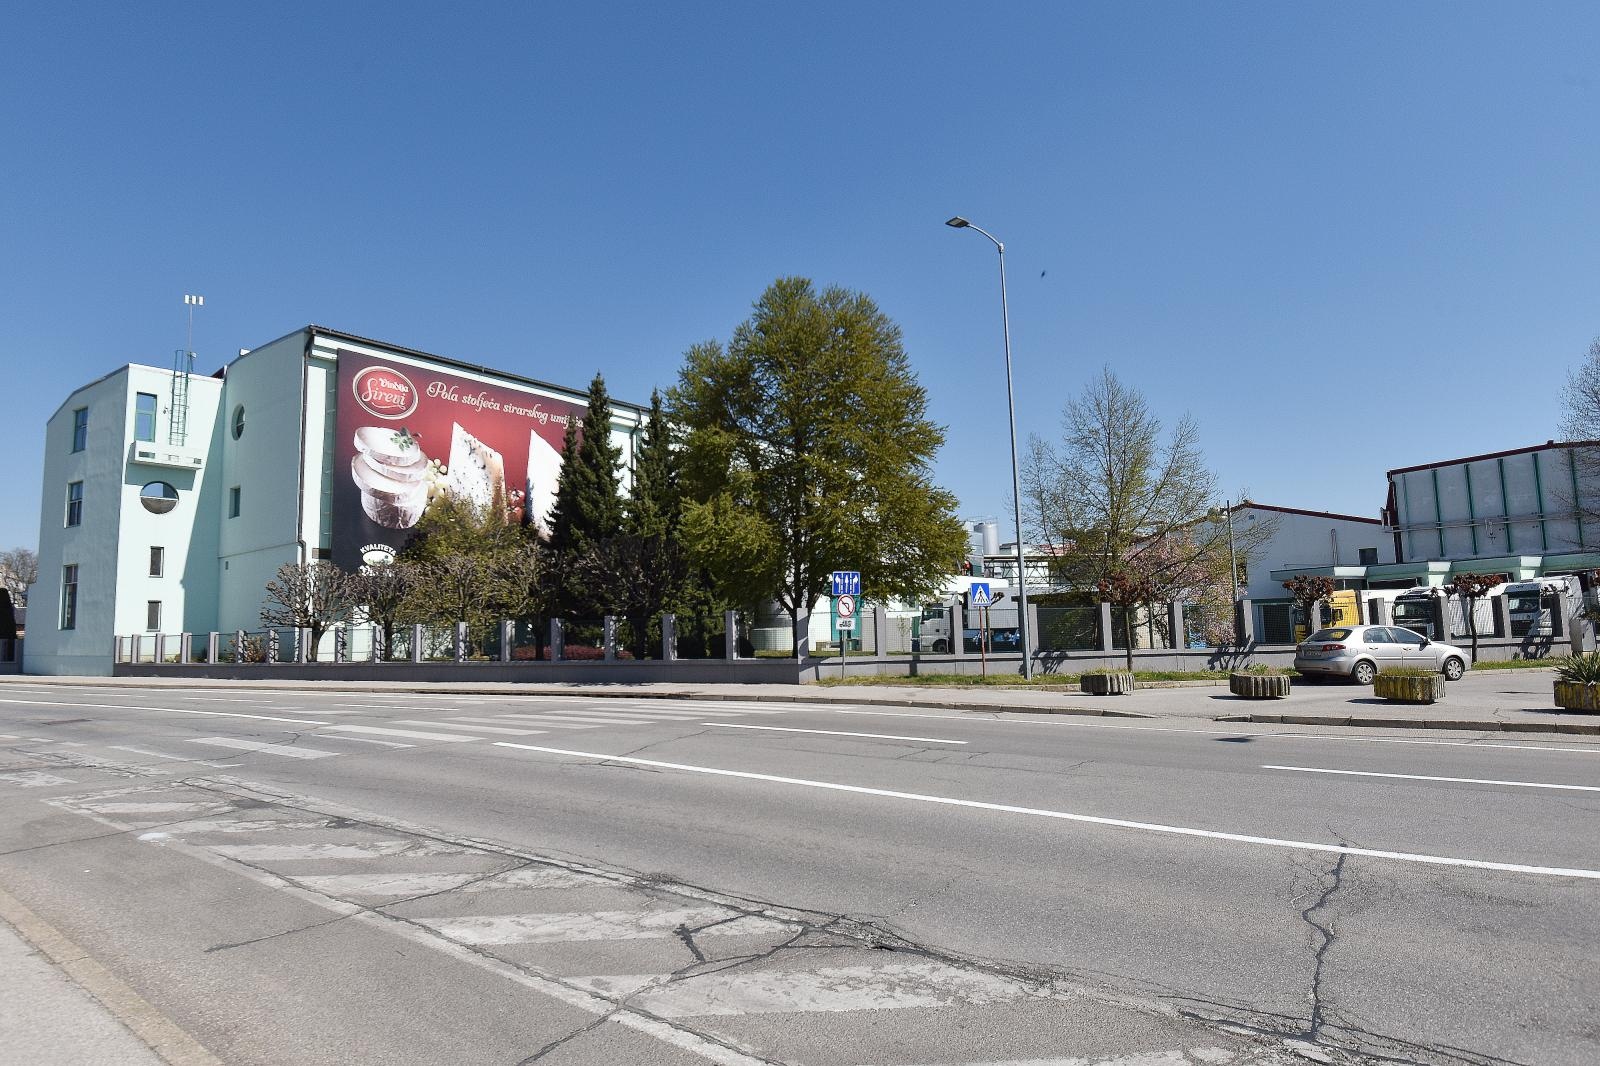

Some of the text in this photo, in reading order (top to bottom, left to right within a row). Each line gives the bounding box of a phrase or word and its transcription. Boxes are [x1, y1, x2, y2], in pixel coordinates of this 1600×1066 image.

[361, 377, 406, 406] Sirevi
[426, 381, 459, 402] Pola
[461, 391, 500, 412] stoljeća
[502, 403, 548, 425] sirarskog
[359, 543, 397, 557] KVALITETA
